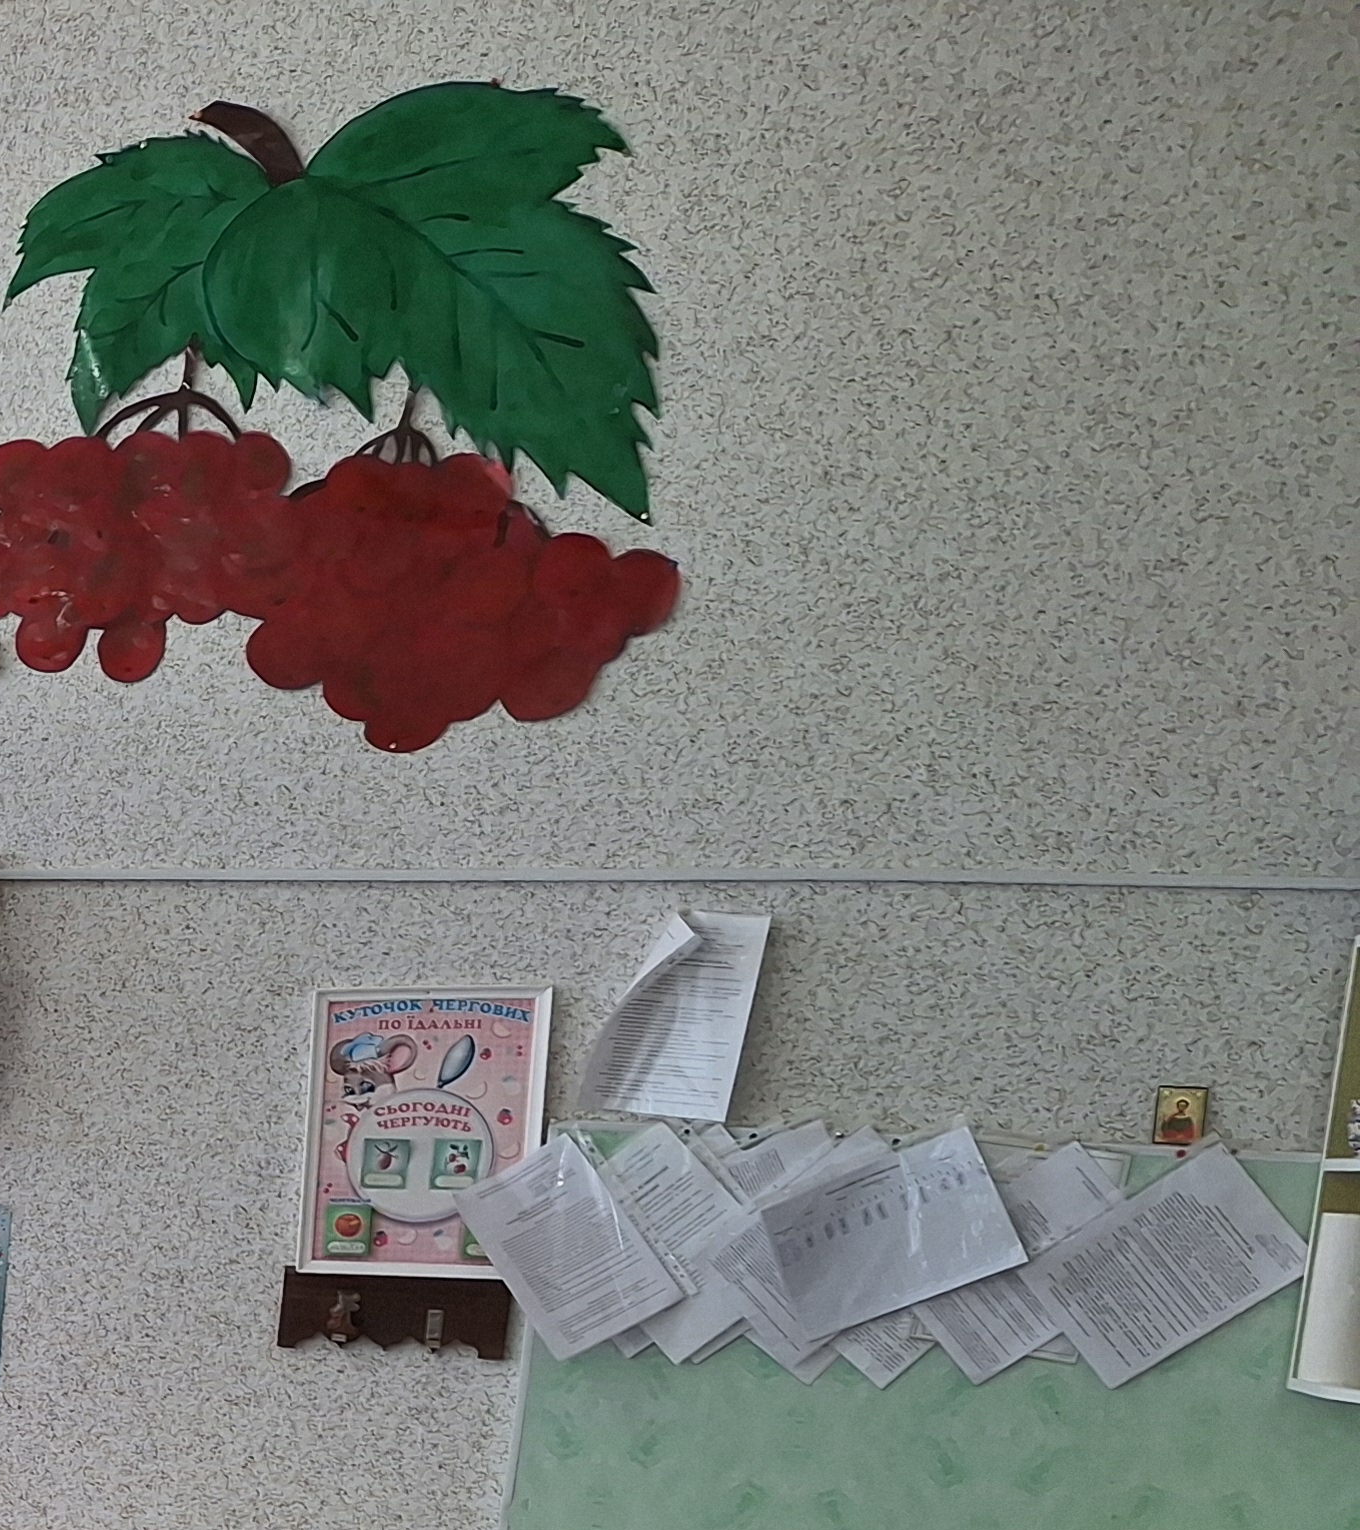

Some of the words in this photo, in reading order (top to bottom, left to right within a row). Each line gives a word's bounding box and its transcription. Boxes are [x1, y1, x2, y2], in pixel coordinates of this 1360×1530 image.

[333, 1000, 423, 1024] КУТОЧОК
[432, 999, 531, 1023] ЧЕРГОВИХ
[378, 1019, 401, 1030] ПО
[407, 1015, 482, 1030] ЇДАЛЬНІ
[373, 1101, 472, 1117] СЬОГОДНІ
[377, 1116, 472, 1132] ЧЕРГУЮТЬ
